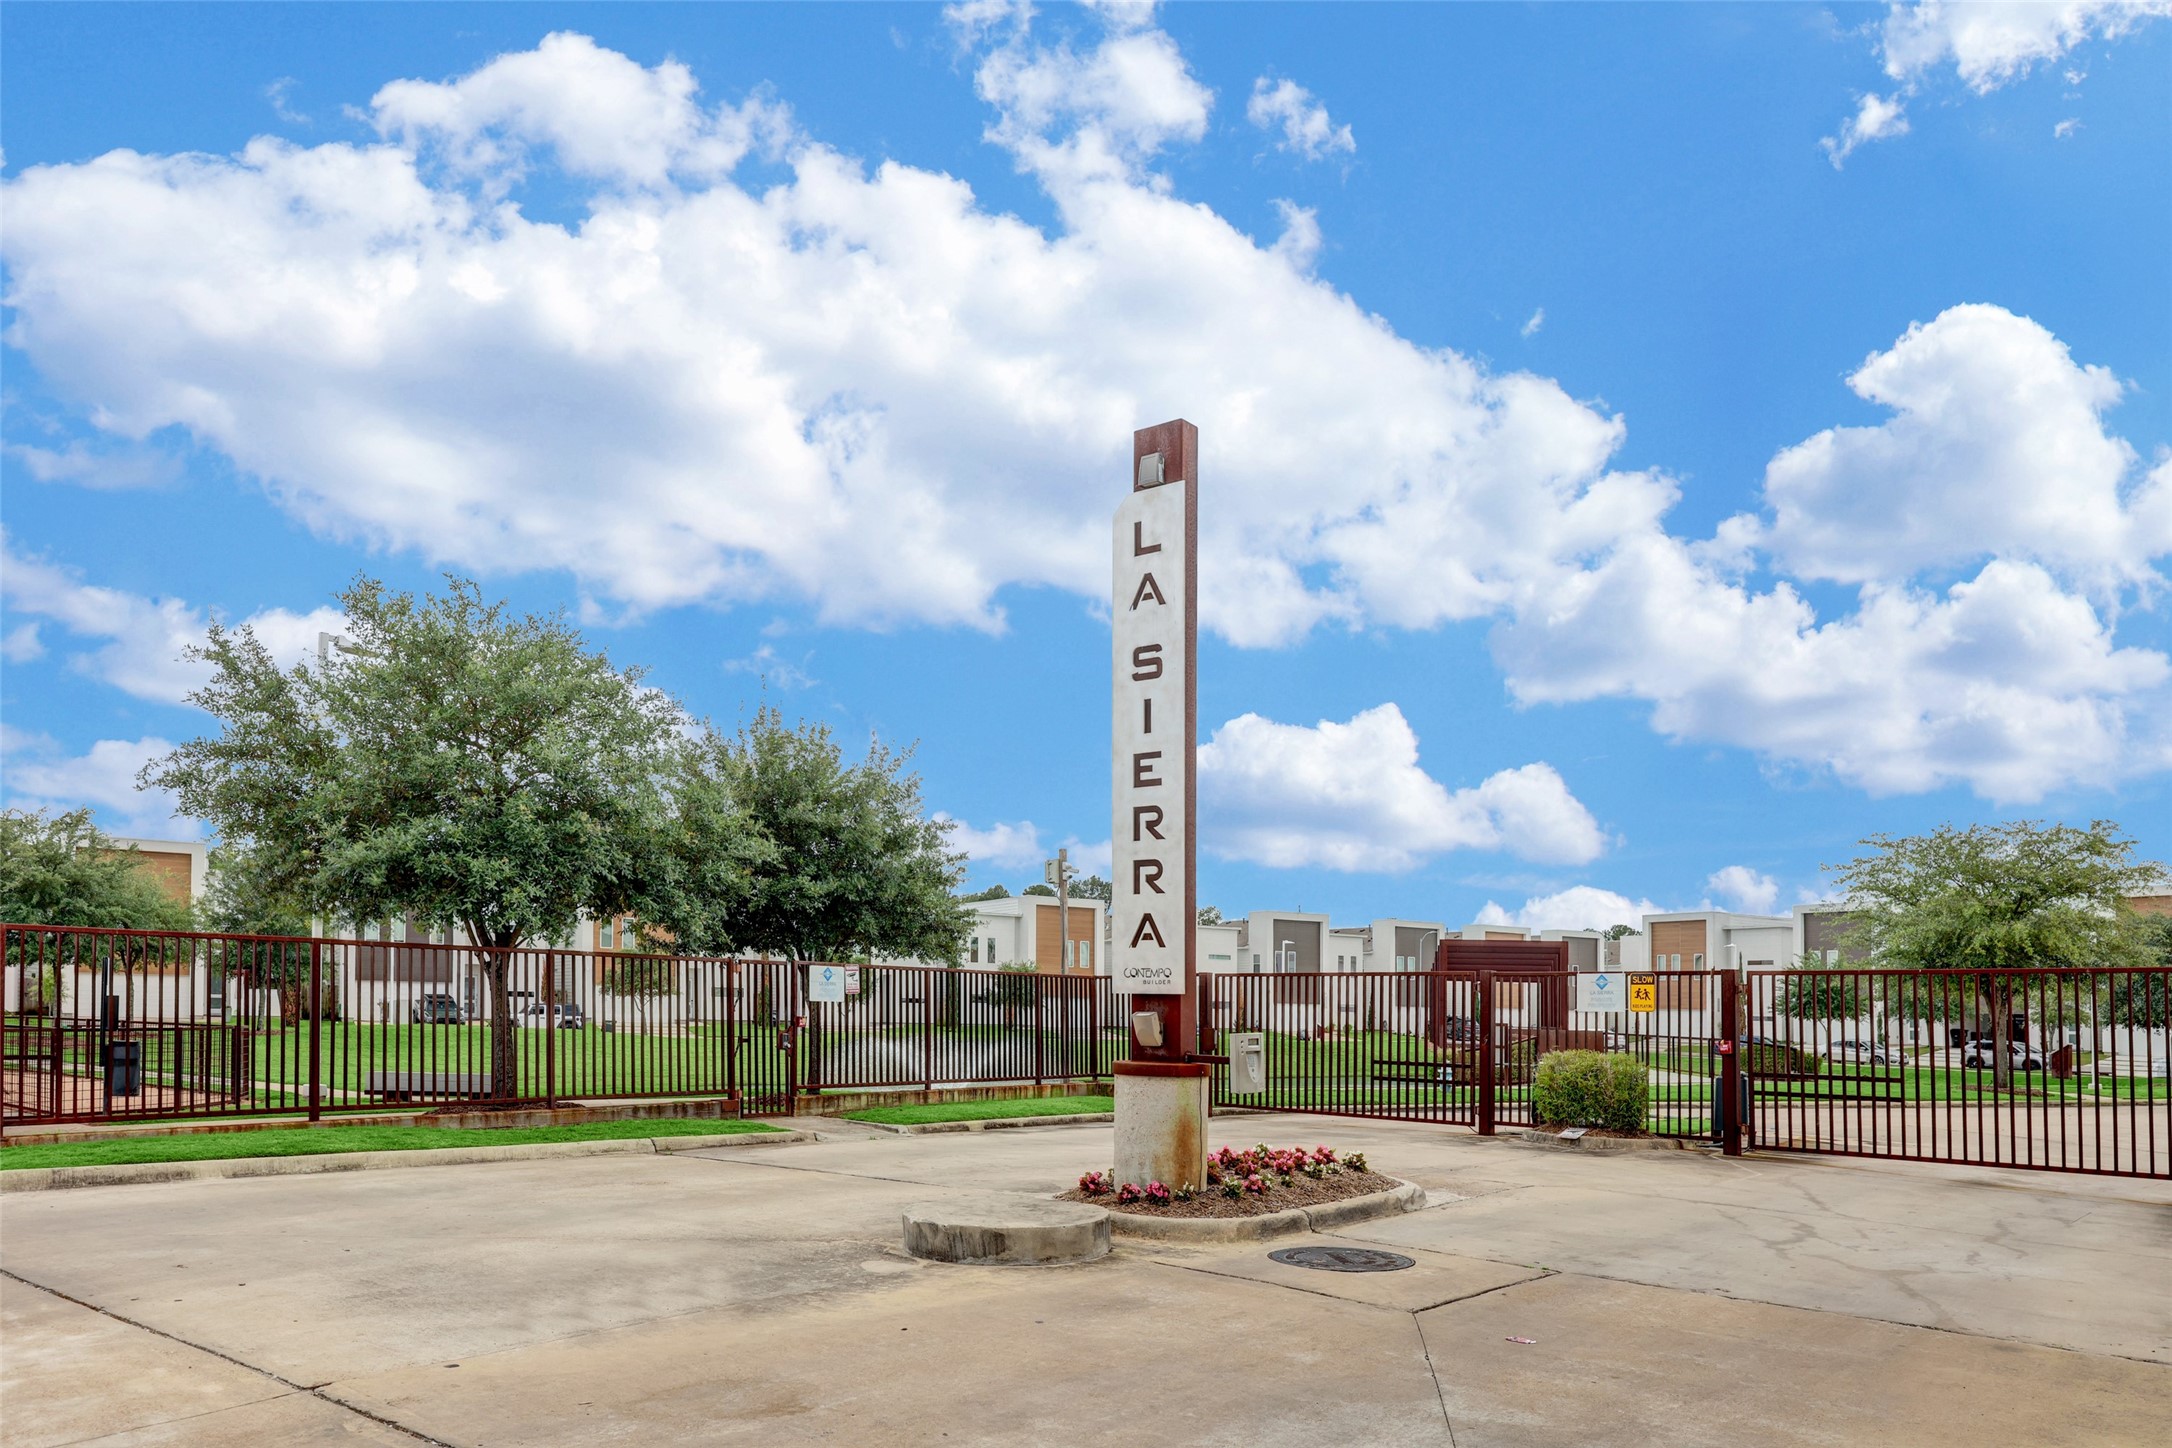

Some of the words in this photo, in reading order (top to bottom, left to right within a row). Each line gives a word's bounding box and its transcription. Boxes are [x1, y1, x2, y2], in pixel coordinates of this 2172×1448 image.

[1130, 520, 1167, 611] LA
[1129, 643, 1167, 949] SIERRA
[1123, 967, 1172, 979] CONTEMPO
[1632, 976, 1654, 984] SLOW
